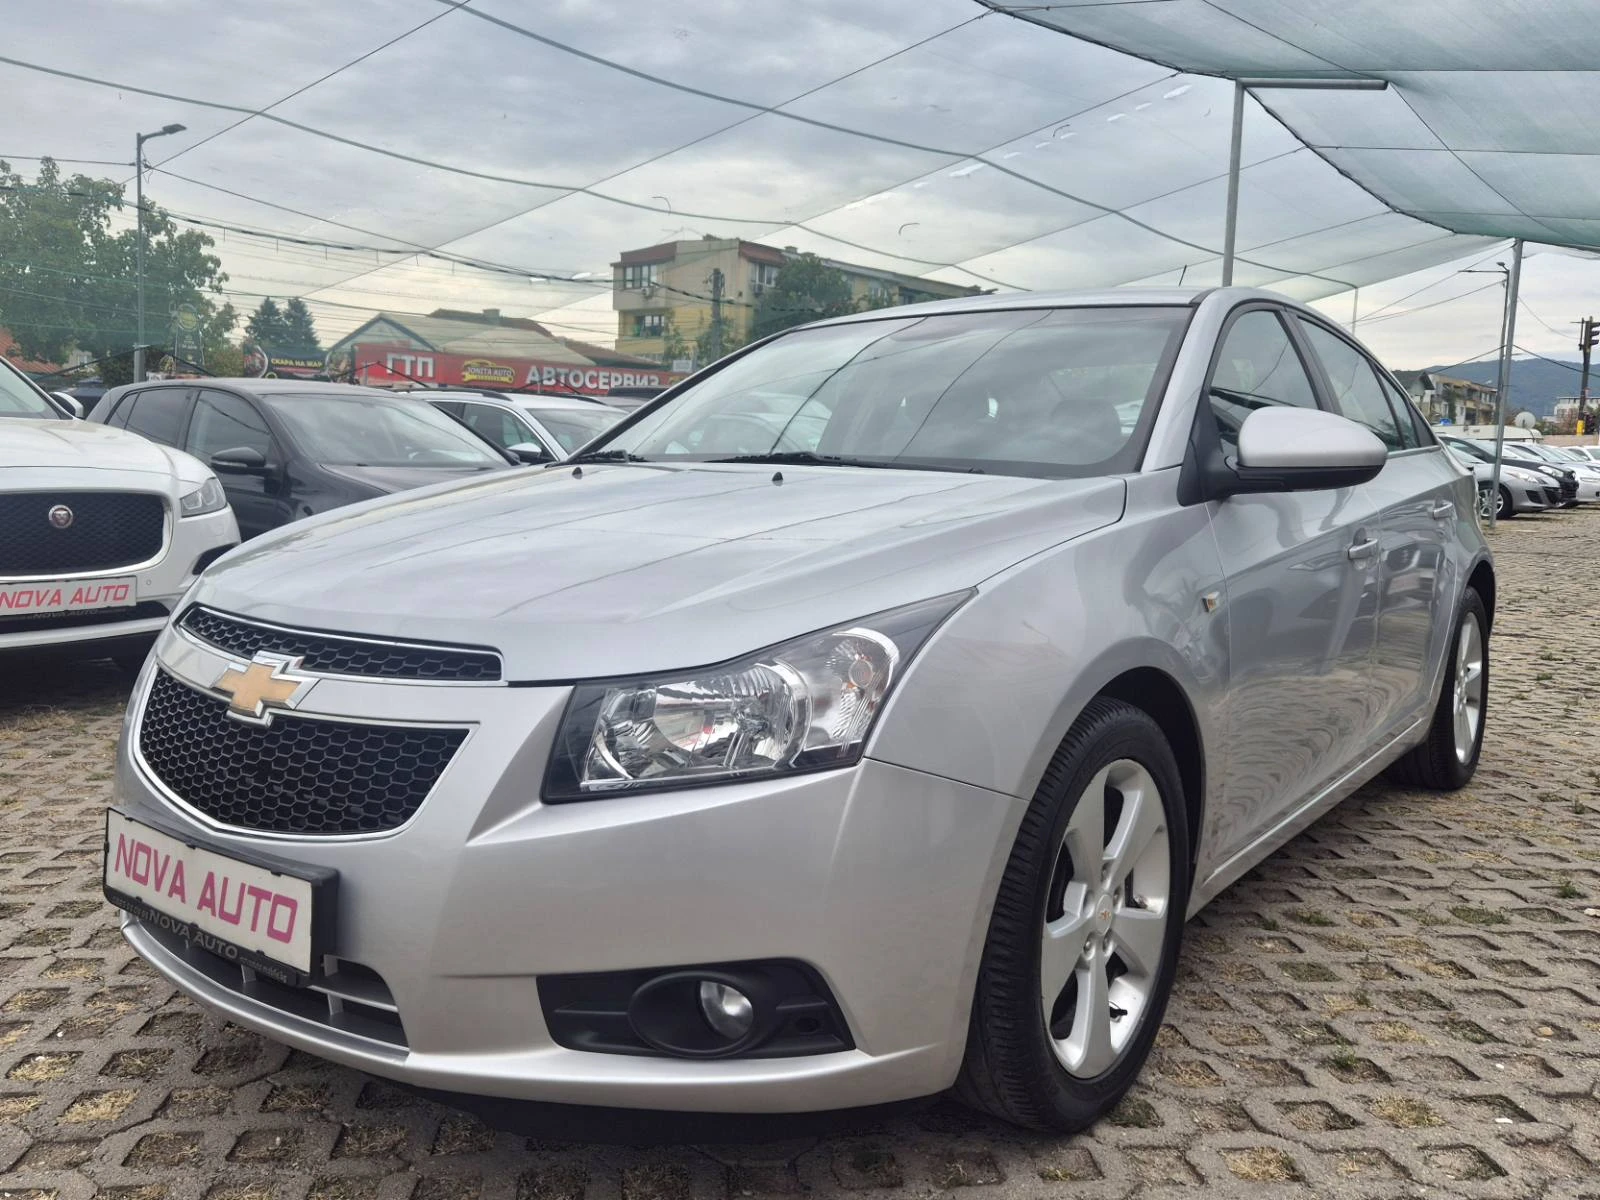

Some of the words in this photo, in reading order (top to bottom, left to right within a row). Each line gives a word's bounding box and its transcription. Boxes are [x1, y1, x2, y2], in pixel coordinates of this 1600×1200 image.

[386, 353, 434, 378] ГТП
[525, 364, 660, 390] АВТОСЕРВИЗ
[0, 588, 62, 609] NOVA
[70, 584, 130, 605] AUTO
[114, 832, 187, 905] NOVA
[196, 870, 299, 944] AUTO
[149, 910, 190, 939] NOVA
[193, 931, 238, 959] AUTO
